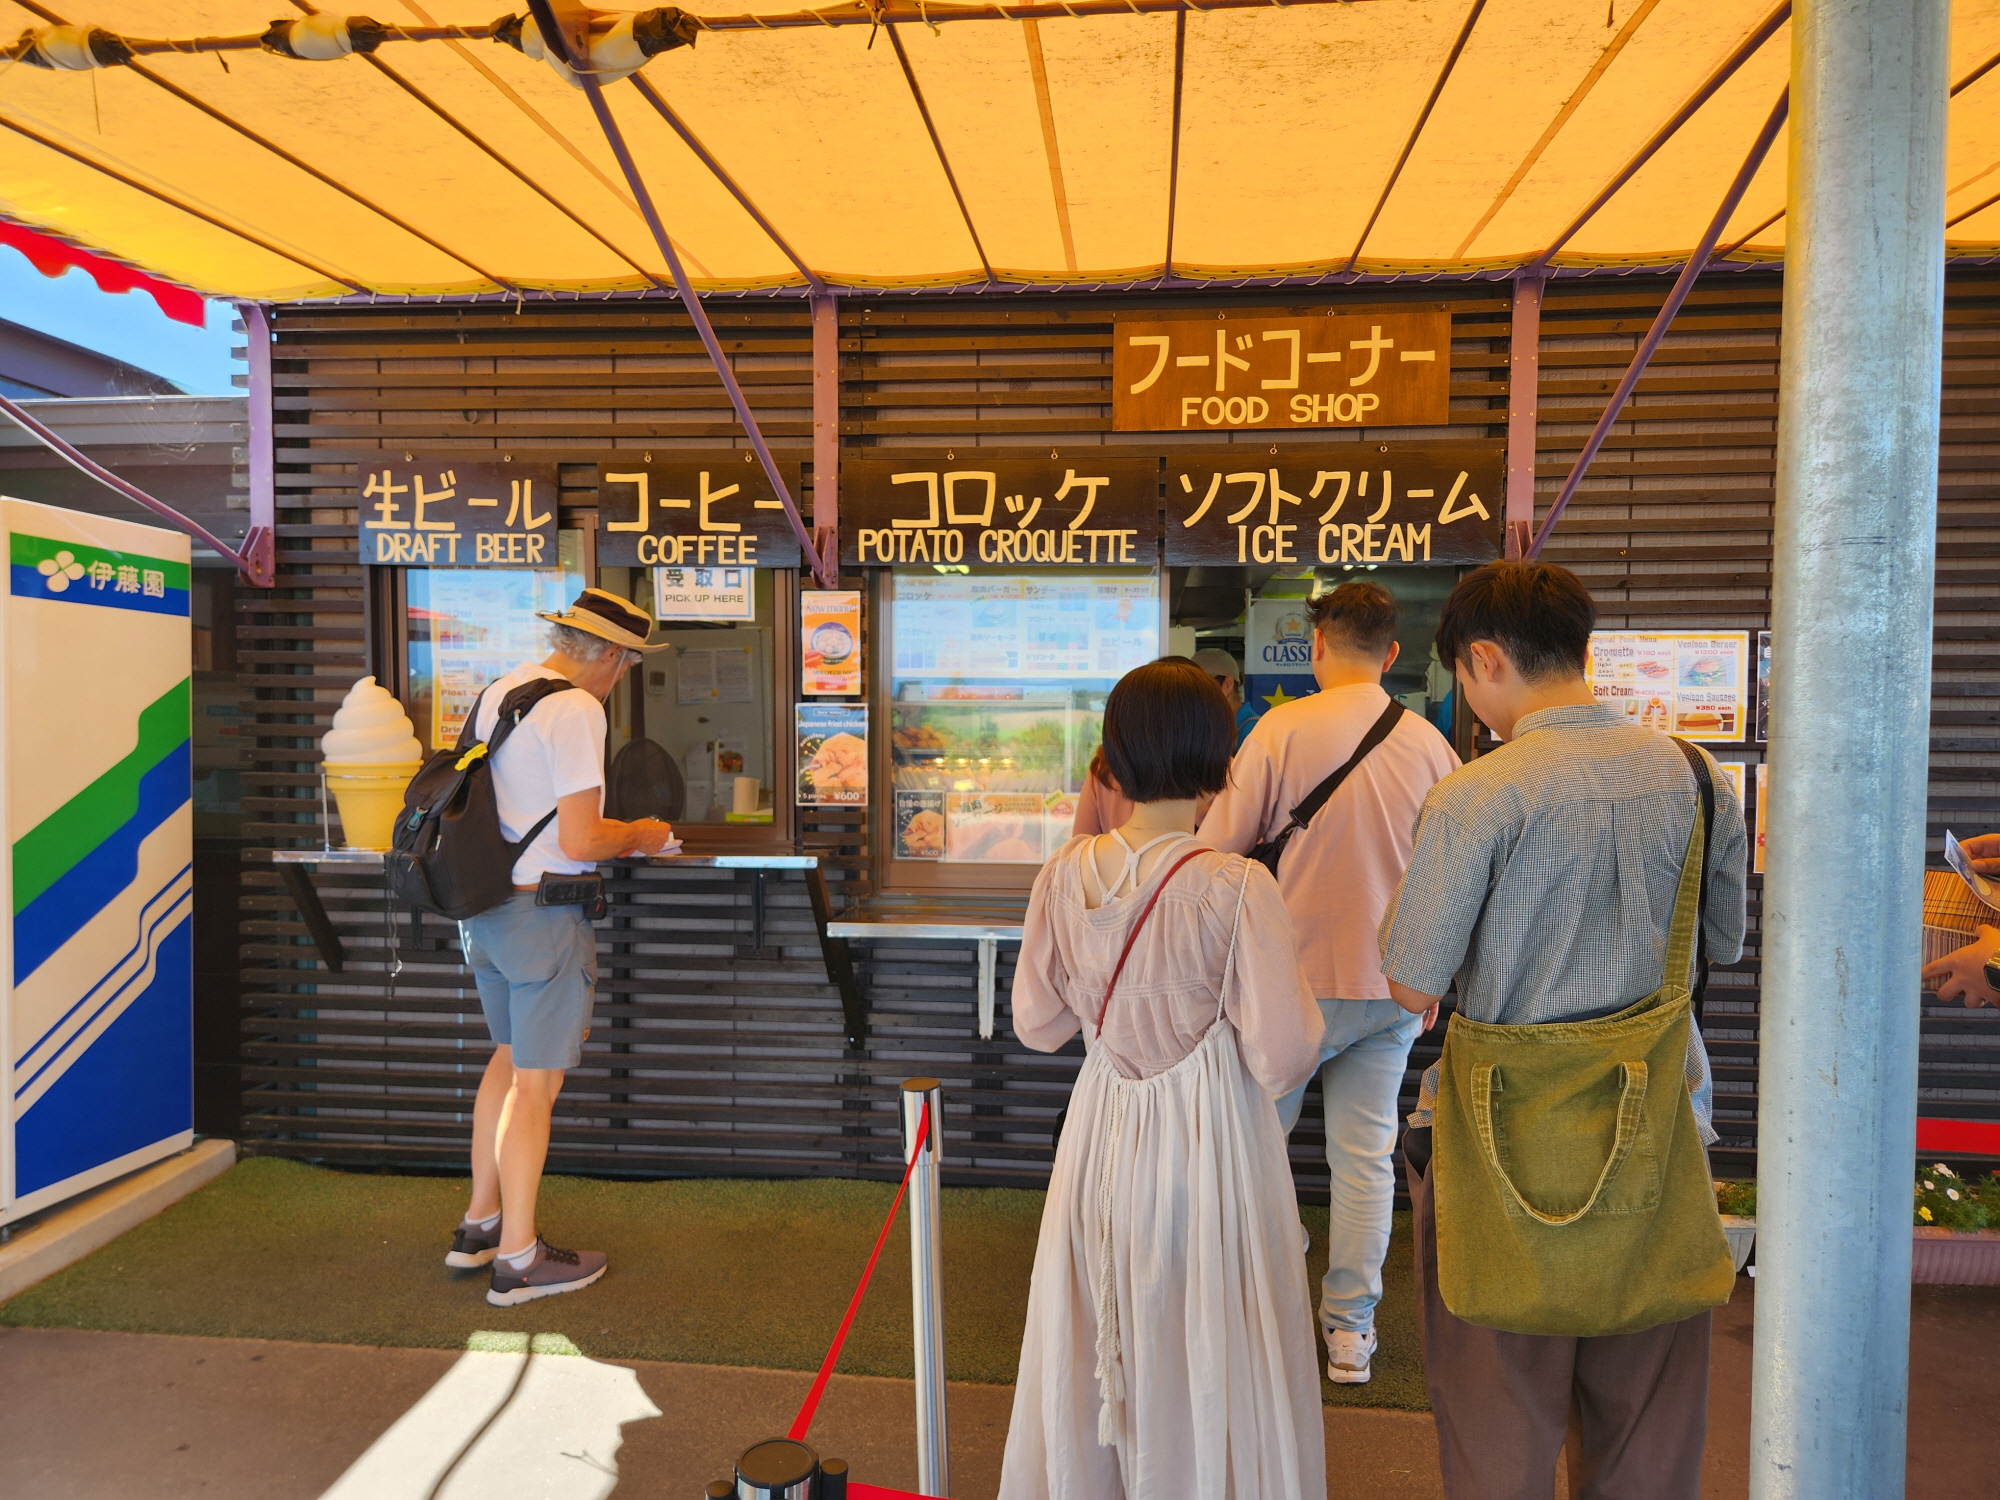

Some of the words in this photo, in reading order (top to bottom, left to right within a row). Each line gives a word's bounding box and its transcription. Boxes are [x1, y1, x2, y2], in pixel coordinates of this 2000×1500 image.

[1129, 326, 1436, 394] フードコーナー
[1181, 397, 1268, 426] FOOD
[1290, 393, 1381, 422] SHOP
[362, 469, 552, 531] 生ビール
[605, 471, 784, 533] コーヒー
[891, 469, 1111, 530] コロッケ
[1180, 468, 1490, 528] ソフトクリーム
[376, 533, 462, 564] DRAFT
[476, 533, 546, 564] BEER
[637, 535, 758, 565] COFFEE
[858, 528, 964, 564] POTATO
[979, 528, 1138, 564] CROQUETTE
[1237, 524, 1297, 563] ICE
[1317, 523, 1431, 563] CREAM
[87, 560, 165, 598] 伊藤園
[666, 569, 743, 588] 受取口
[665, 593, 691, 603] PICK
[694, 593, 710, 603] UP
[713, 593, 744, 603] HERE
[897, 592, 932, 601] コロッケ
[806, 604, 826, 613] New
[1619, 635, 1636, 643] Food
[1639, 635, 1657, 643] Menu
[1677, 640, 1707, 648] Venison
[1710, 640, 1737, 649] Burger
[1262, 645, 1312, 663] CLASSI
[1593, 646, 1634, 658] Croquette
[1593, 685, 1609, 696] Soft
[1611, 685, 1634, 696] Cream
[1676, 692, 1704, 702] Venison
[1706, 692, 1737, 703] Sausage
[798, 720, 827, 728] Japanese
[828, 720, 842, 728] fried
[834, 791, 860, 801] ¥600
